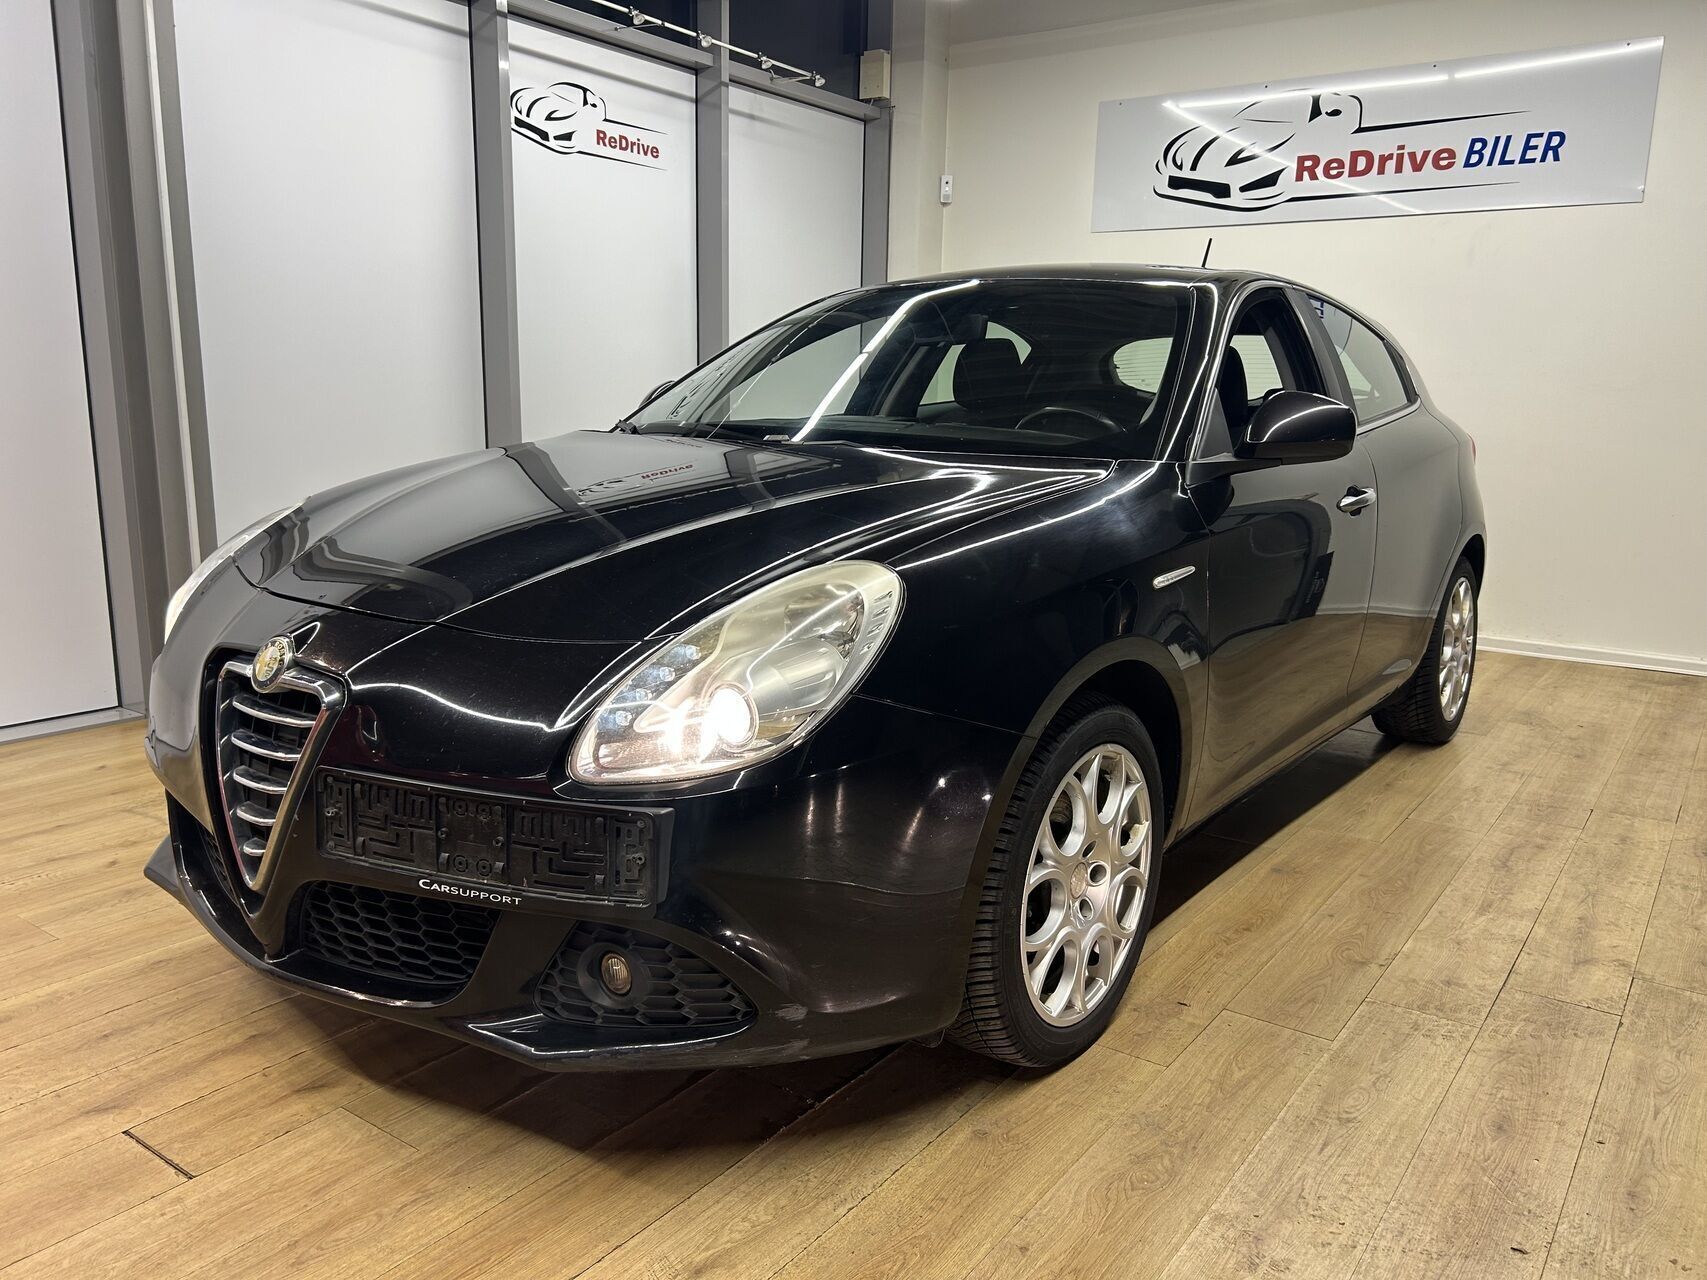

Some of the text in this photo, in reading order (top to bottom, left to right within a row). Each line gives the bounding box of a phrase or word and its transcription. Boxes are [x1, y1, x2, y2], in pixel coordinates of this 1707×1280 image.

[595, 129, 660, 159] ReDrive
[1294, 130, 1567, 183] ReDrive BILER
